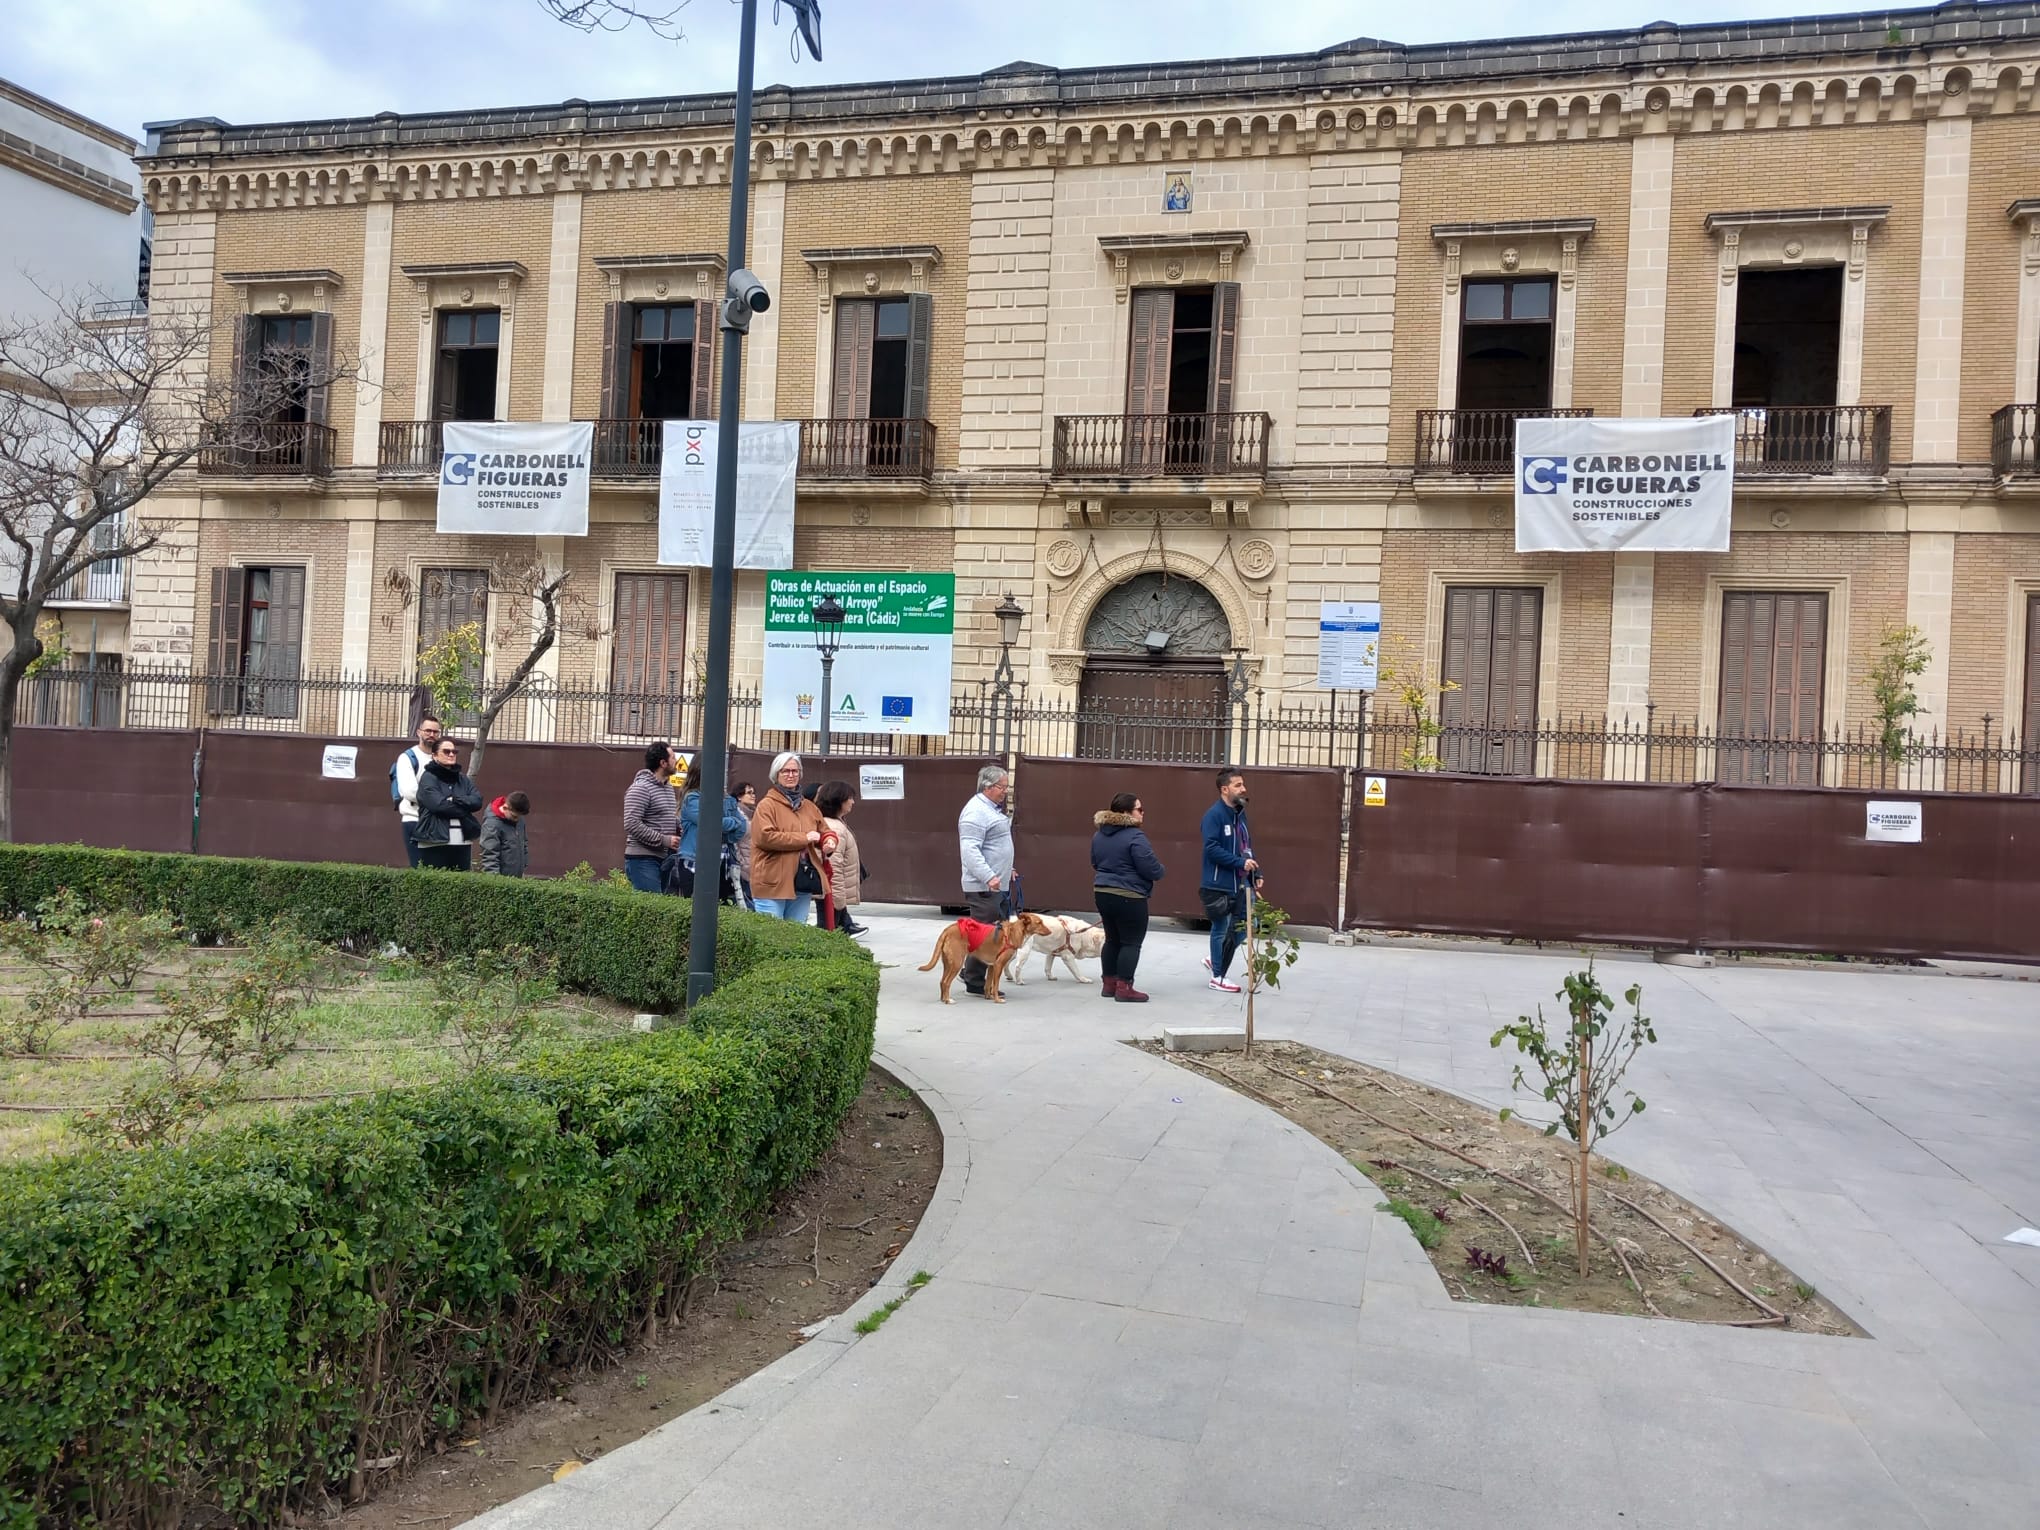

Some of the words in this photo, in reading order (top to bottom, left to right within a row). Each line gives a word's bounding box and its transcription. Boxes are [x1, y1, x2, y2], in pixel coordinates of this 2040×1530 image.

[480, 454, 584, 468] CARBONELL
[1573, 454, 1726, 472] CARBONELL
[478, 472, 568, 486] FIGUERAS
[1572, 476, 1701, 494] FIGUERAS
[478, 490, 562, 499] CONSTRUCCIONES
[477, 500, 540, 509] SOSTENIBLES
[1572, 498, 1692, 508] CONSTRUCCIONES
[1572, 512, 1661, 521] SOSTENIBLES
[770, 578, 798, 592] Obras
[800, 579, 812, 592] de
[814, 579, 862, 593] Actuación
[864, 583, 876, 593] en
[878, 580, 887, 594] el
[890, 580, 927, 596] Espacio
[770, 594, 804, 608] Público
[769, 610, 796, 624] Jerez
[798, 610, 810, 624] de
[866, 611, 900, 628] (Cádiz)
